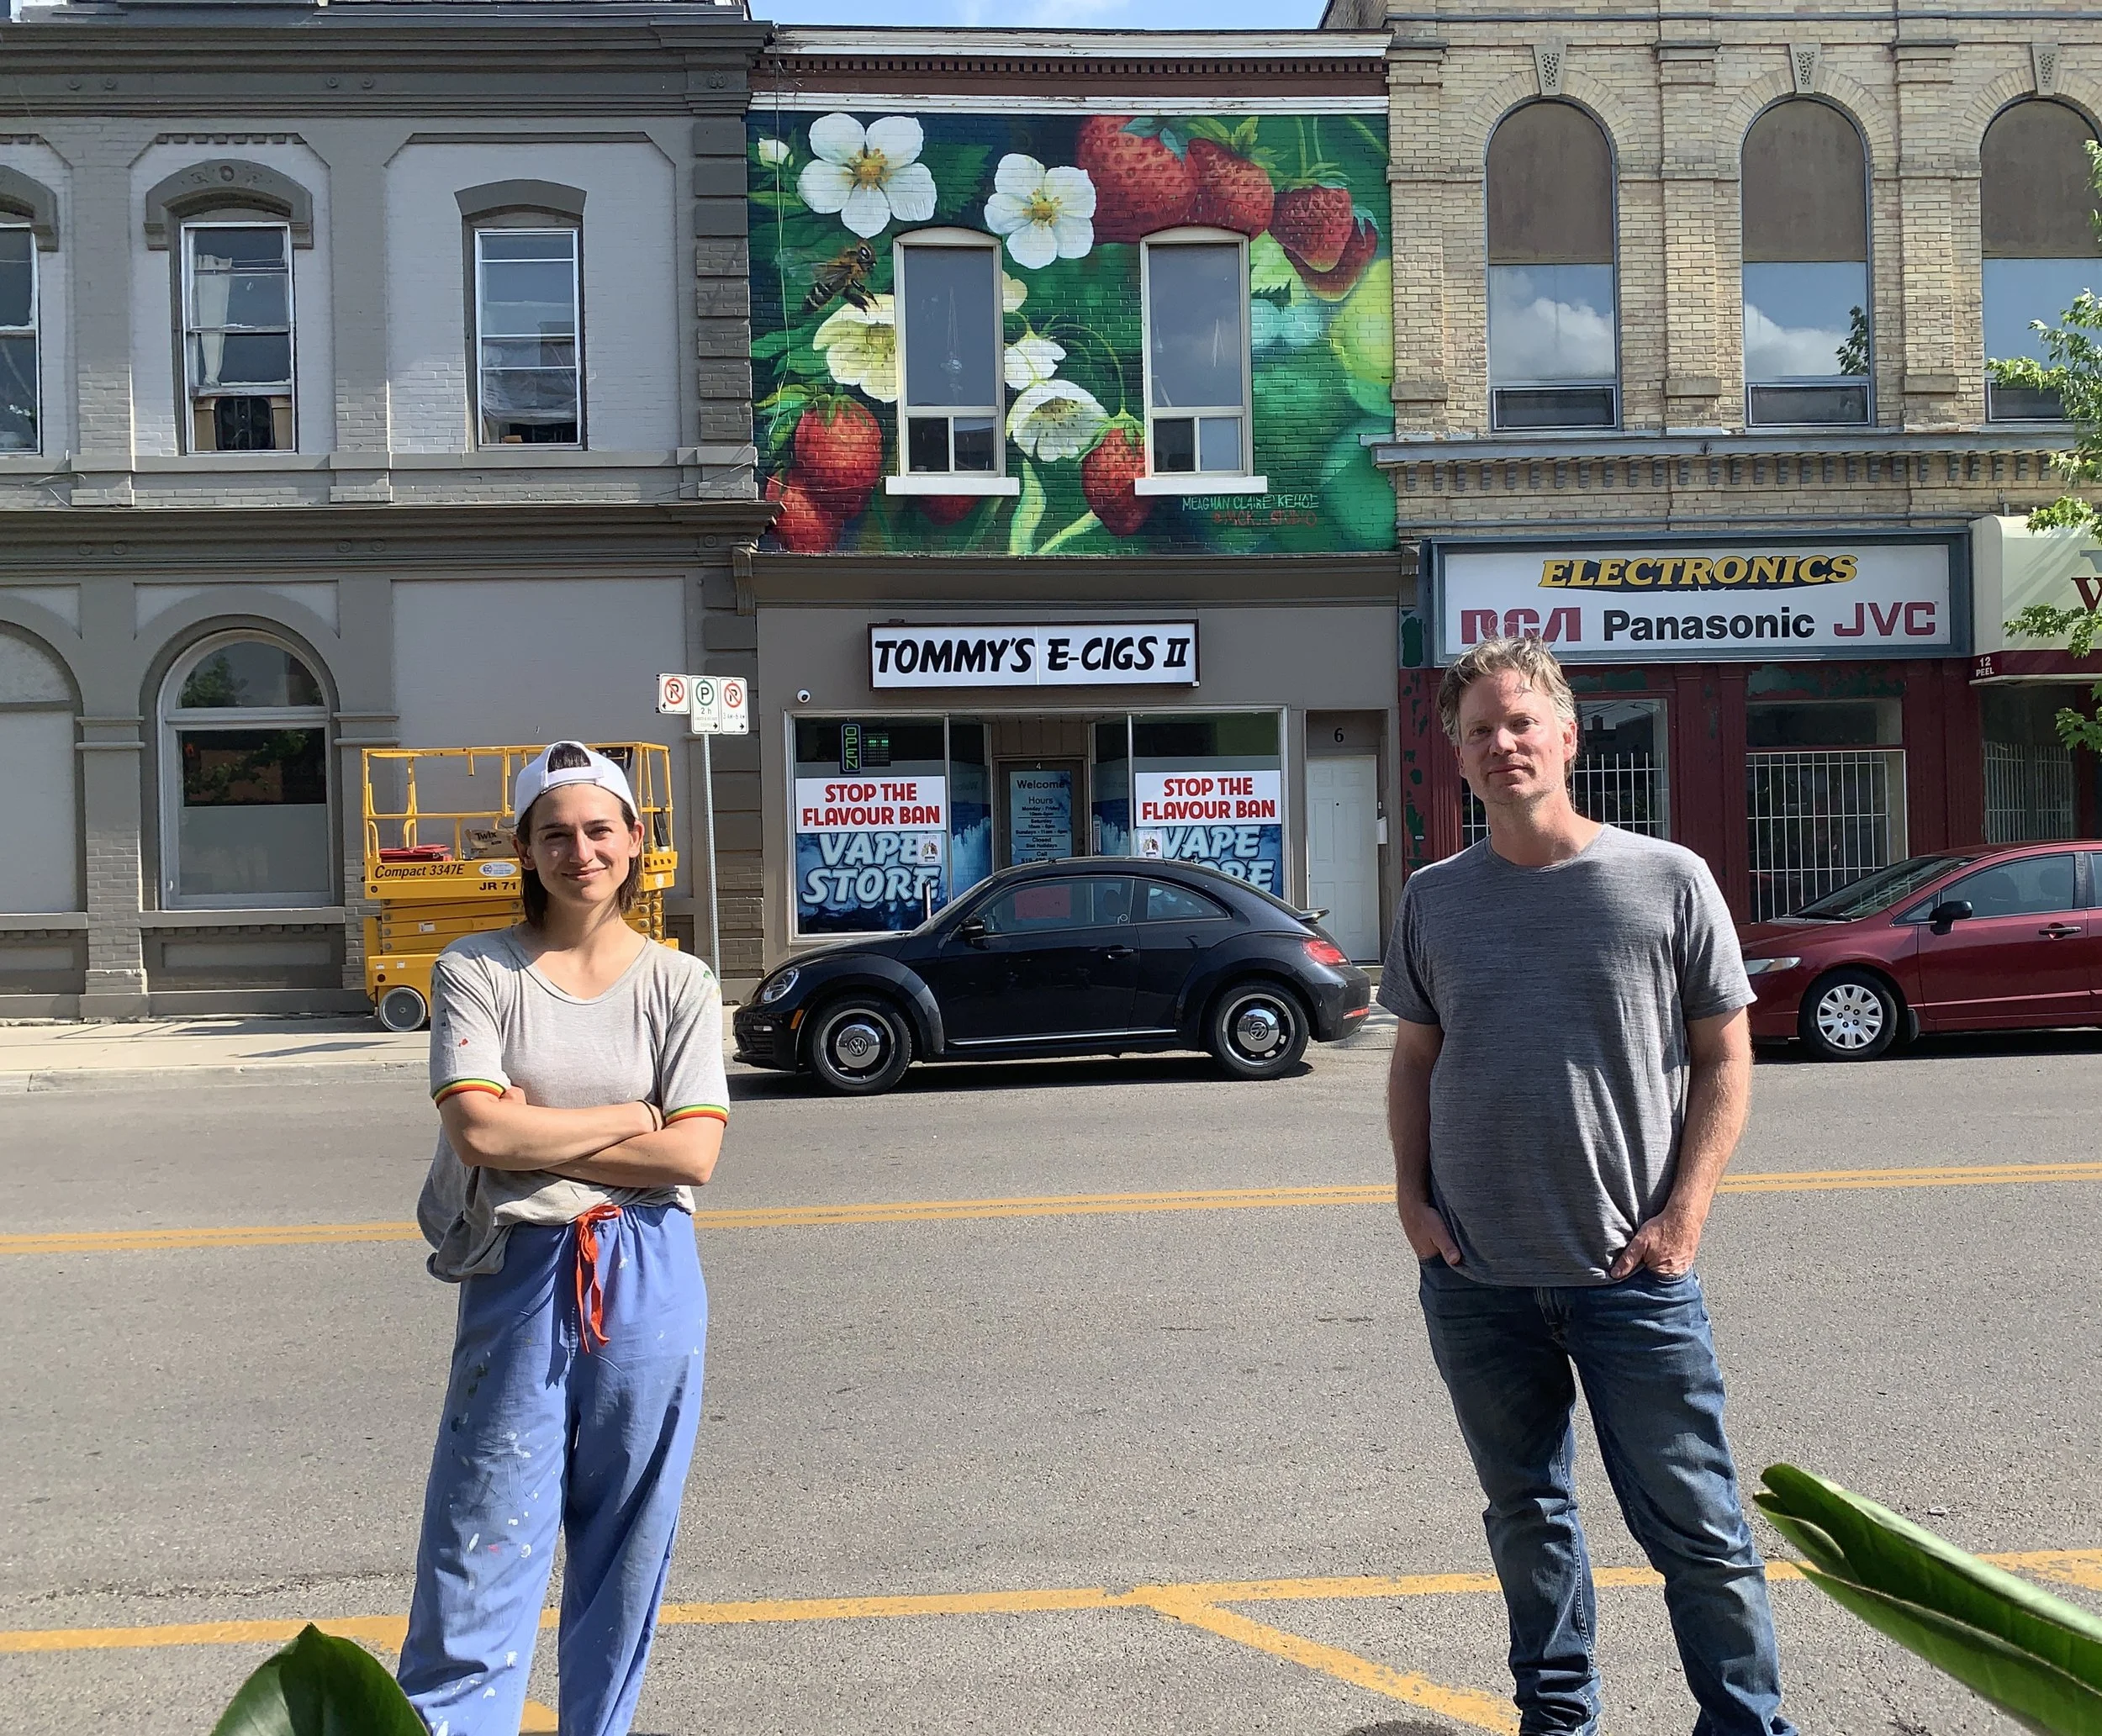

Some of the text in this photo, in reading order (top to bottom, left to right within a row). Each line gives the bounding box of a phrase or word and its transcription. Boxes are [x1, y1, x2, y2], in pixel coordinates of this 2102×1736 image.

[1182, 496, 1231, 511] MEAGHAN
[1233, 495, 1272, 509] CLAIRE
[1537, 555, 1860, 588] ELECTRONICS
[1460, 601, 1936, 645] RCA Panasonic JVC
[874, 636, 1191, 673] TOMMY'S E-CIGS II
[1979, 656, 1992, 667] 12
[1975, 667, 1995, 678] PEEL
[1334, 727, 1344, 743] 6
[845, 726, 858, 769] OPEN
[825, 783, 917, 803] STOP THE
[1016, 779, 1065, 789] Welcome
[1164, 777, 1253, 797] STOP THE
[1028, 796, 1054, 805] Hours
[1142, 799, 1275, 821] FLAVOUR BAN
[802, 805, 940, 826] FLAVOUR BAN
[818, 831, 918, 867] VAPE
[1162, 825, 1261, 859] VAPE
[374, 863, 465, 879] Compact 3347E
[478, 881, 517, 891] JR 71
[800, 865, 943, 905] STORE
